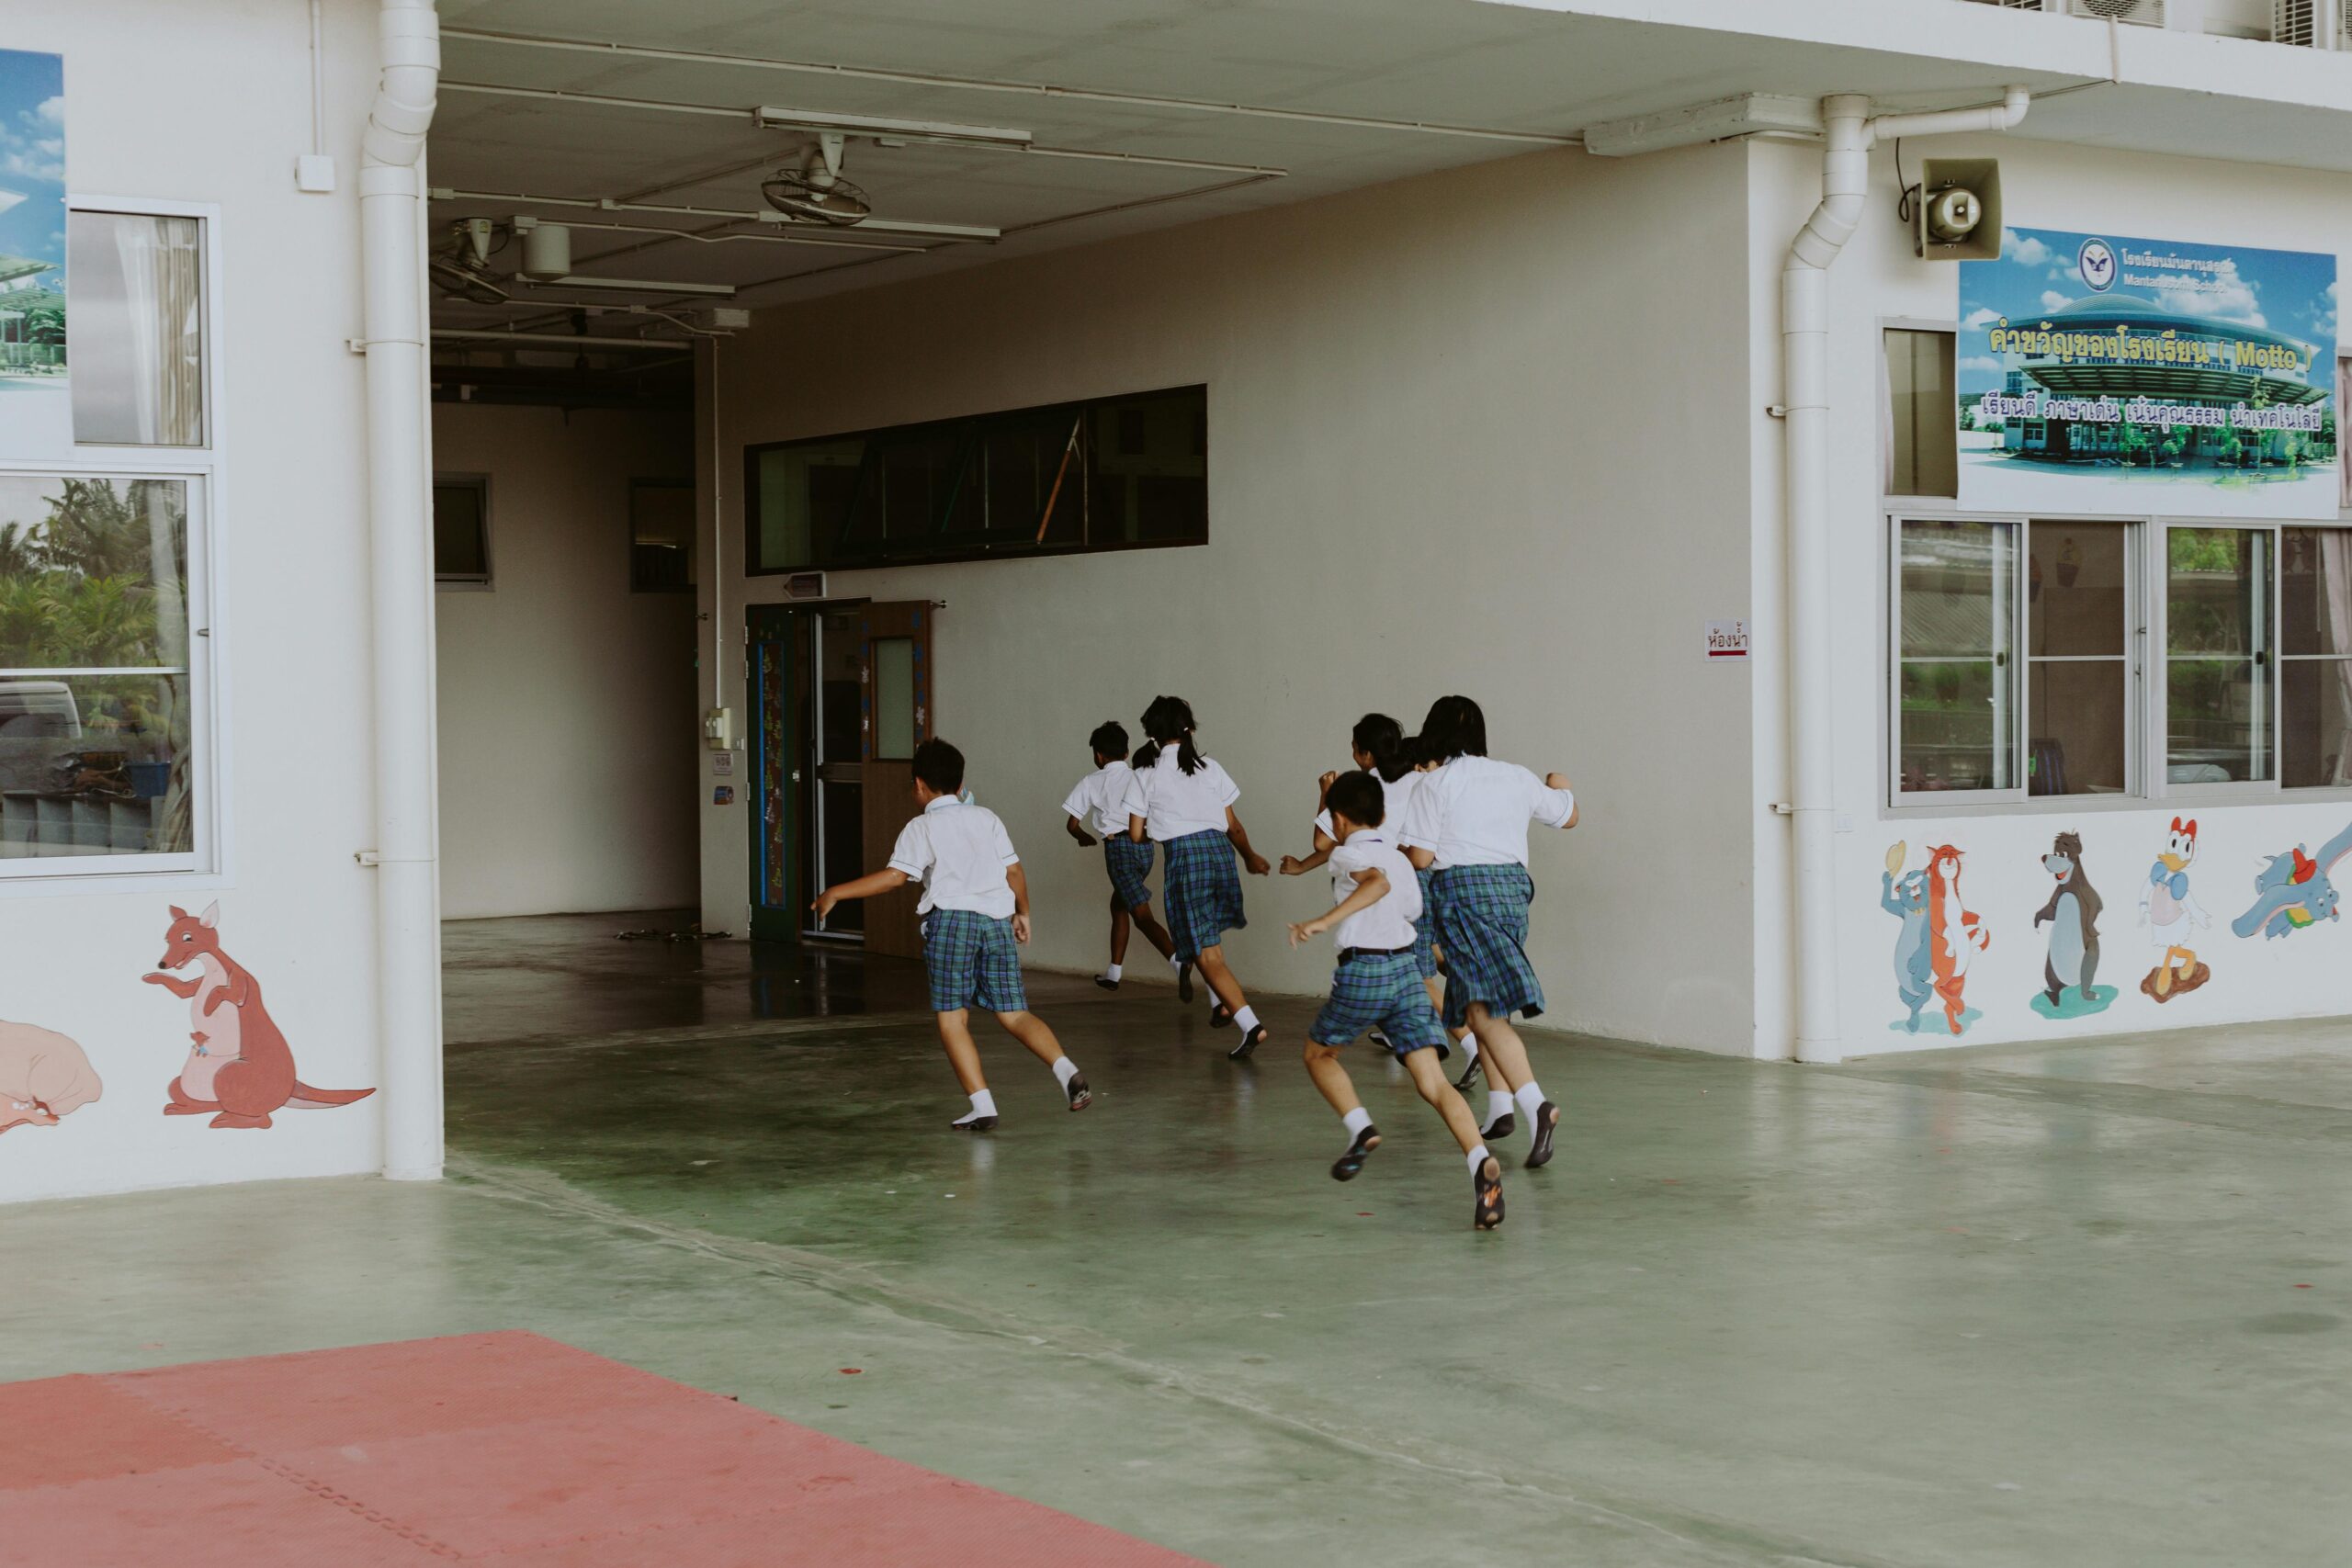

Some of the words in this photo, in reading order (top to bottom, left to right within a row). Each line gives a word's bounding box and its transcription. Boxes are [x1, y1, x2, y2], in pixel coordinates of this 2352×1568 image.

[1989, 317, 2210, 363] คำขวัญของโรงเรียน
[2234, 340, 2297, 370] Motto
[1982, 390, 2037, 417] เรียนดี
[2044, 396, 2120, 422] ภาษาเด่น
[2126, 396, 2225, 433] เน้นคุณธรรม
[2231, 402, 2322, 430] นำเทคโนโลยี
[1707, 621, 1748, 648] ห้องน้ำ
